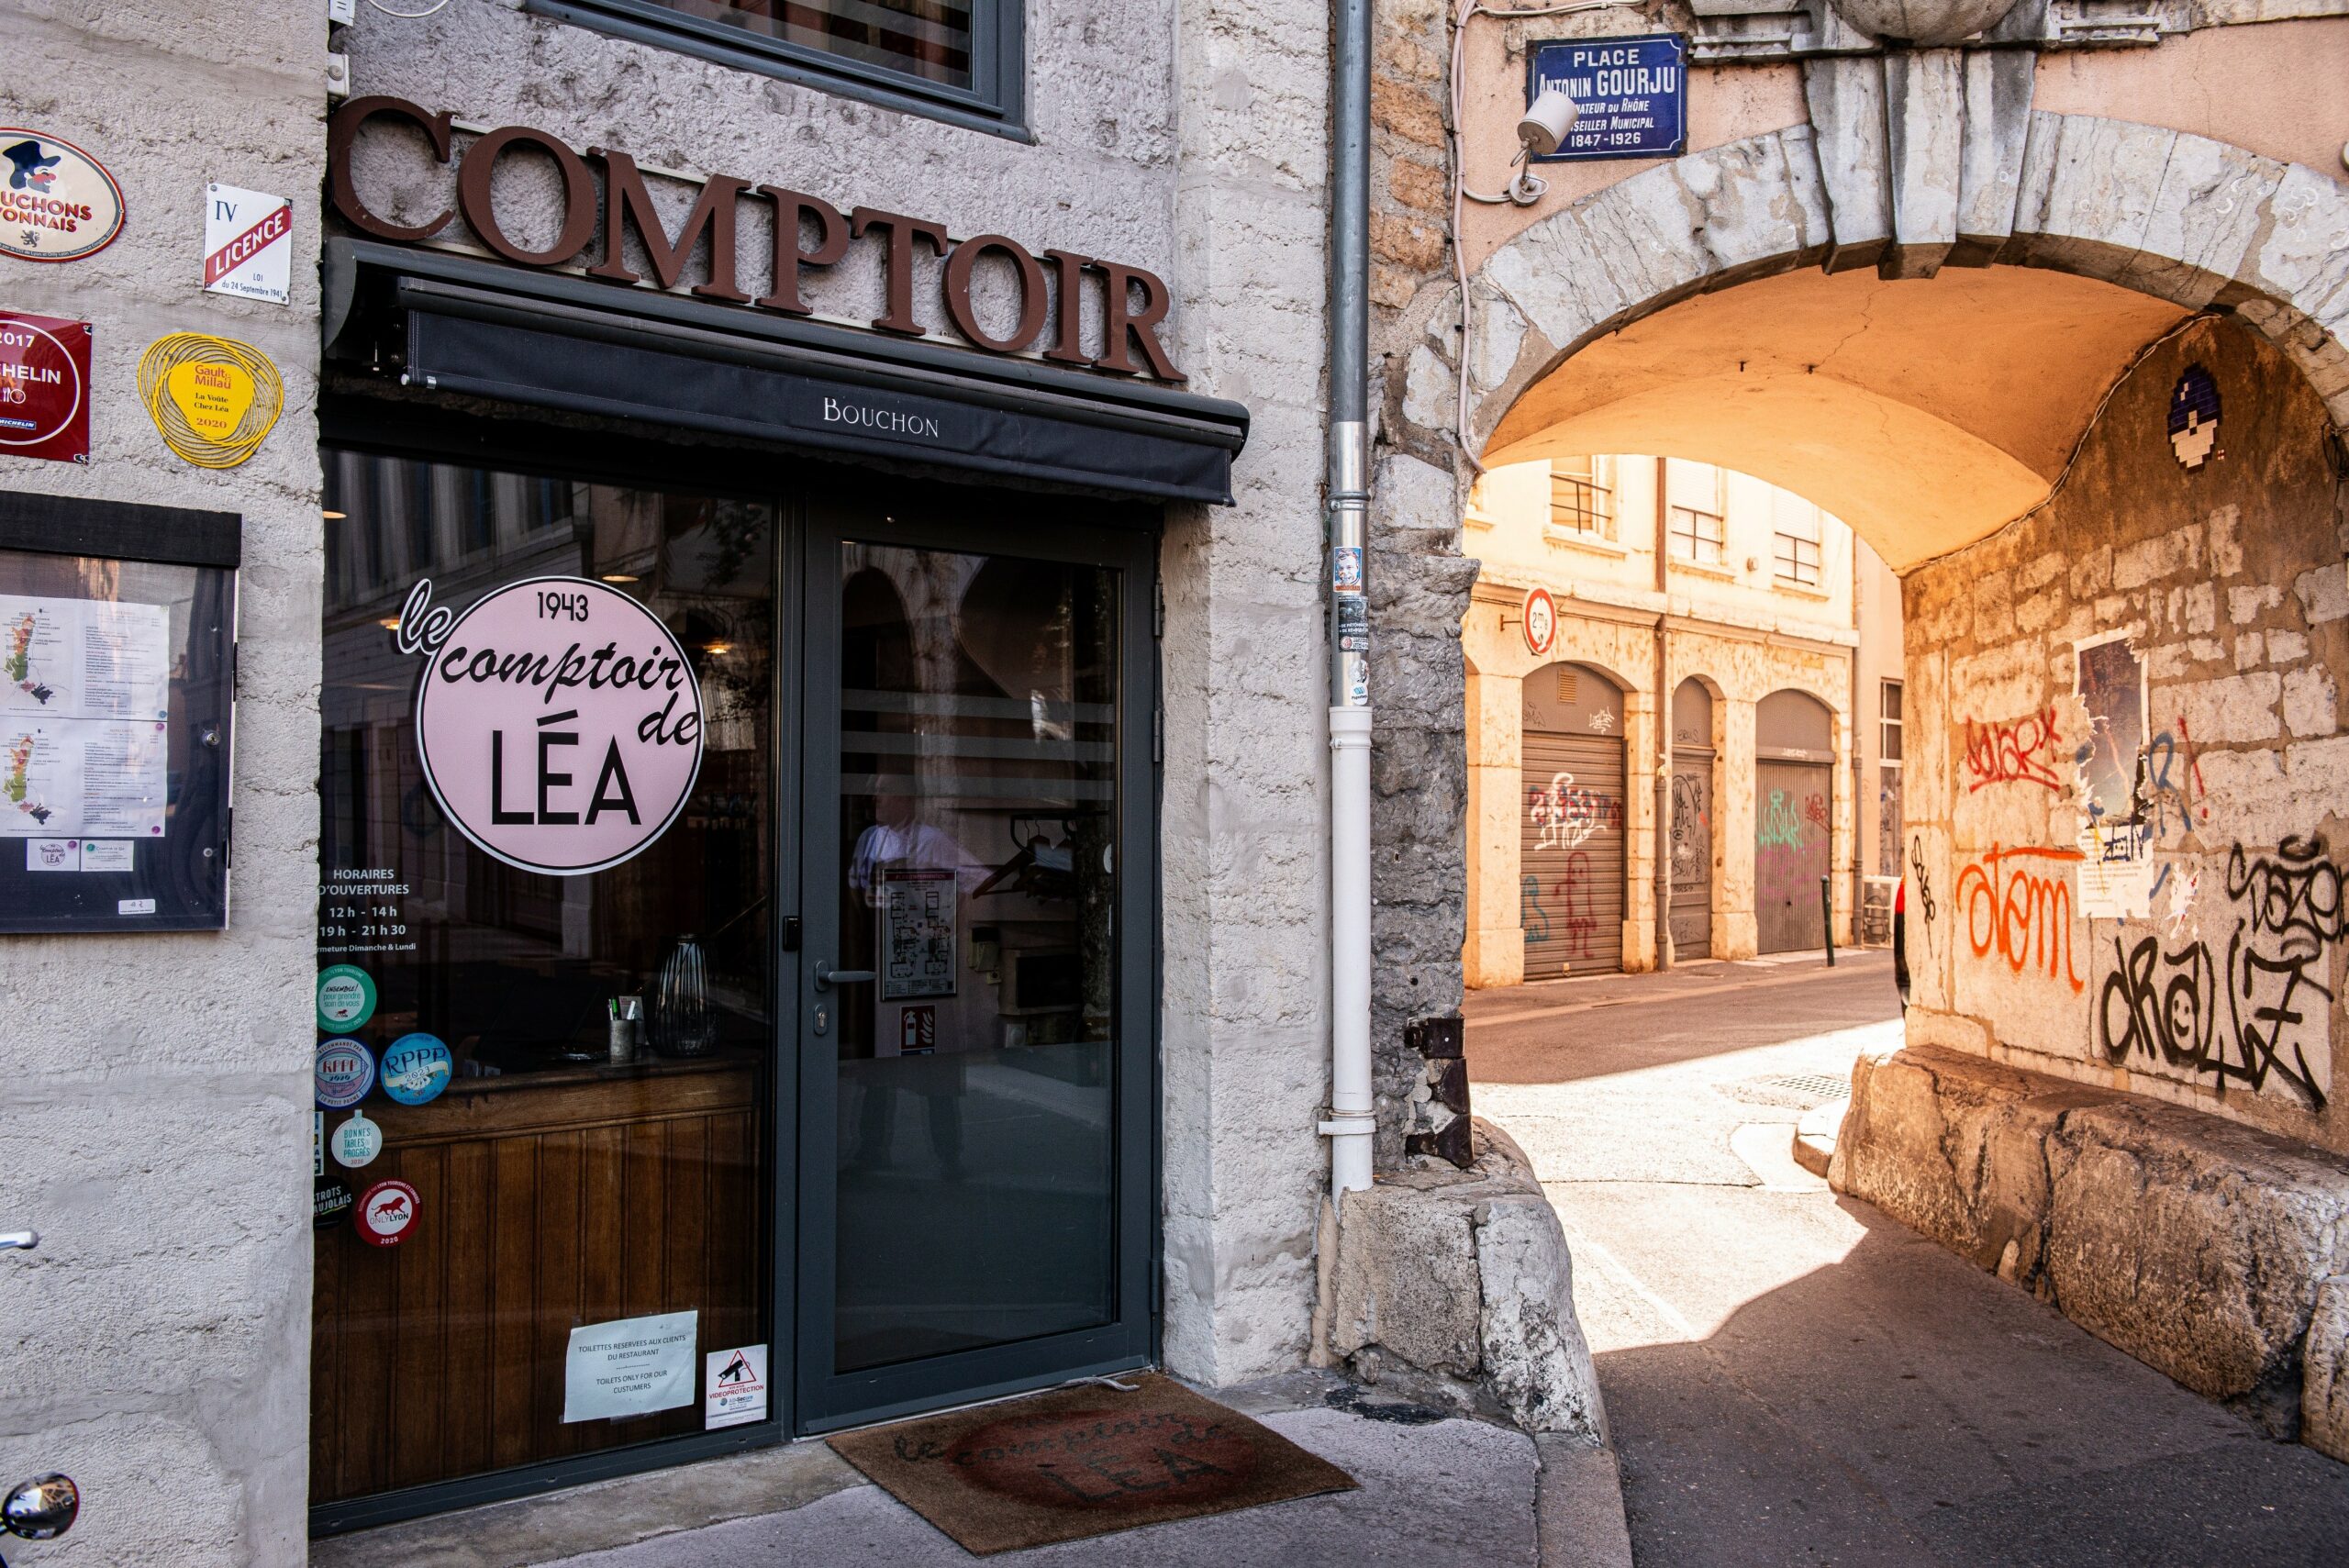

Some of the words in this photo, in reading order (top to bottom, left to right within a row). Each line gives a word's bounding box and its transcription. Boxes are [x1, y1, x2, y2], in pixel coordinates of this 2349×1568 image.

[1574, 49, 1640, 68] PLACE
[1597, 67, 1675, 96] GOURJU
[1575, 102, 1606, 115] NATEUR
[1608, 103, 1619, 113] DU
[1621, 97, 1650, 113] RHÔNE
[1570, 119, 1608, 132] SEILLER
[1610, 116, 1654, 131] MUNICIPAL
[0, 190, 93, 221] UCHONS
[216, 200, 238, 222] IV
[215, 212, 284, 276] LICENCE
[328, 95, 1187, 383] COMPTOIR
[252, 273, 263, 282] LOI
[221, 280, 229, 289] du
[231, 281, 239, 290] 24
[239, 283, 269, 296] Septembre
[270, 289, 283, 298] 1941
[0, 332, 35, 348] 017
[0, 363, 61, 384] HELIN
[195, 375, 231, 389] Millau
[195, 392, 205, 400] La
[194, 402, 213, 410] Chez
[196, 417, 228, 428] 2020
[823, 396, 940, 439] BOUCHON
[537, 591, 589, 622] 1943
[397, 578, 452, 656] le
[440, 642, 684, 705] comptoir
[637, 691, 700, 746] de
[491, 709, 642, 825] LÉA
[333, 869, 395, 880] HORAIRES
[317, 944, 348, 953] rmeture
[349, 943, 386, 952] Dimanche
[395, 942, 417, 951] Lundi
[338, 992, 360, 1000] prendre
[344, 1128, 371, 1139] BONNES
[344, 1138, 365, 1149] TABLES
[314, 1185, 341, 1203] TROTS
[314, 1193, 352, 1214] AUJOLAIS
[380, 1236, 399, 1244] 2020
[578, 1343, 612, 1353] TOILETTES
[613, 1340, 648, 1350] RESERVEES
[648, 1337, 662, 1346] AUX
[662, 1334, 686, 1344] CLIENTS
[607, 1352, 618, 1361] DU
[619, 1348, 660, 1360] RESTAURANT
[596, 1376, 621, 1385] TOILETS
[622, 1373, 640, 1384] ONLY
[640, 1372, 653, 1380] FOR
[654, 1370, 668, 1378] OUR
[613, 1382, 651, 1394] CUSTUMERS
[708, 1384, 764, 1399] VIDEOPROTECTION
